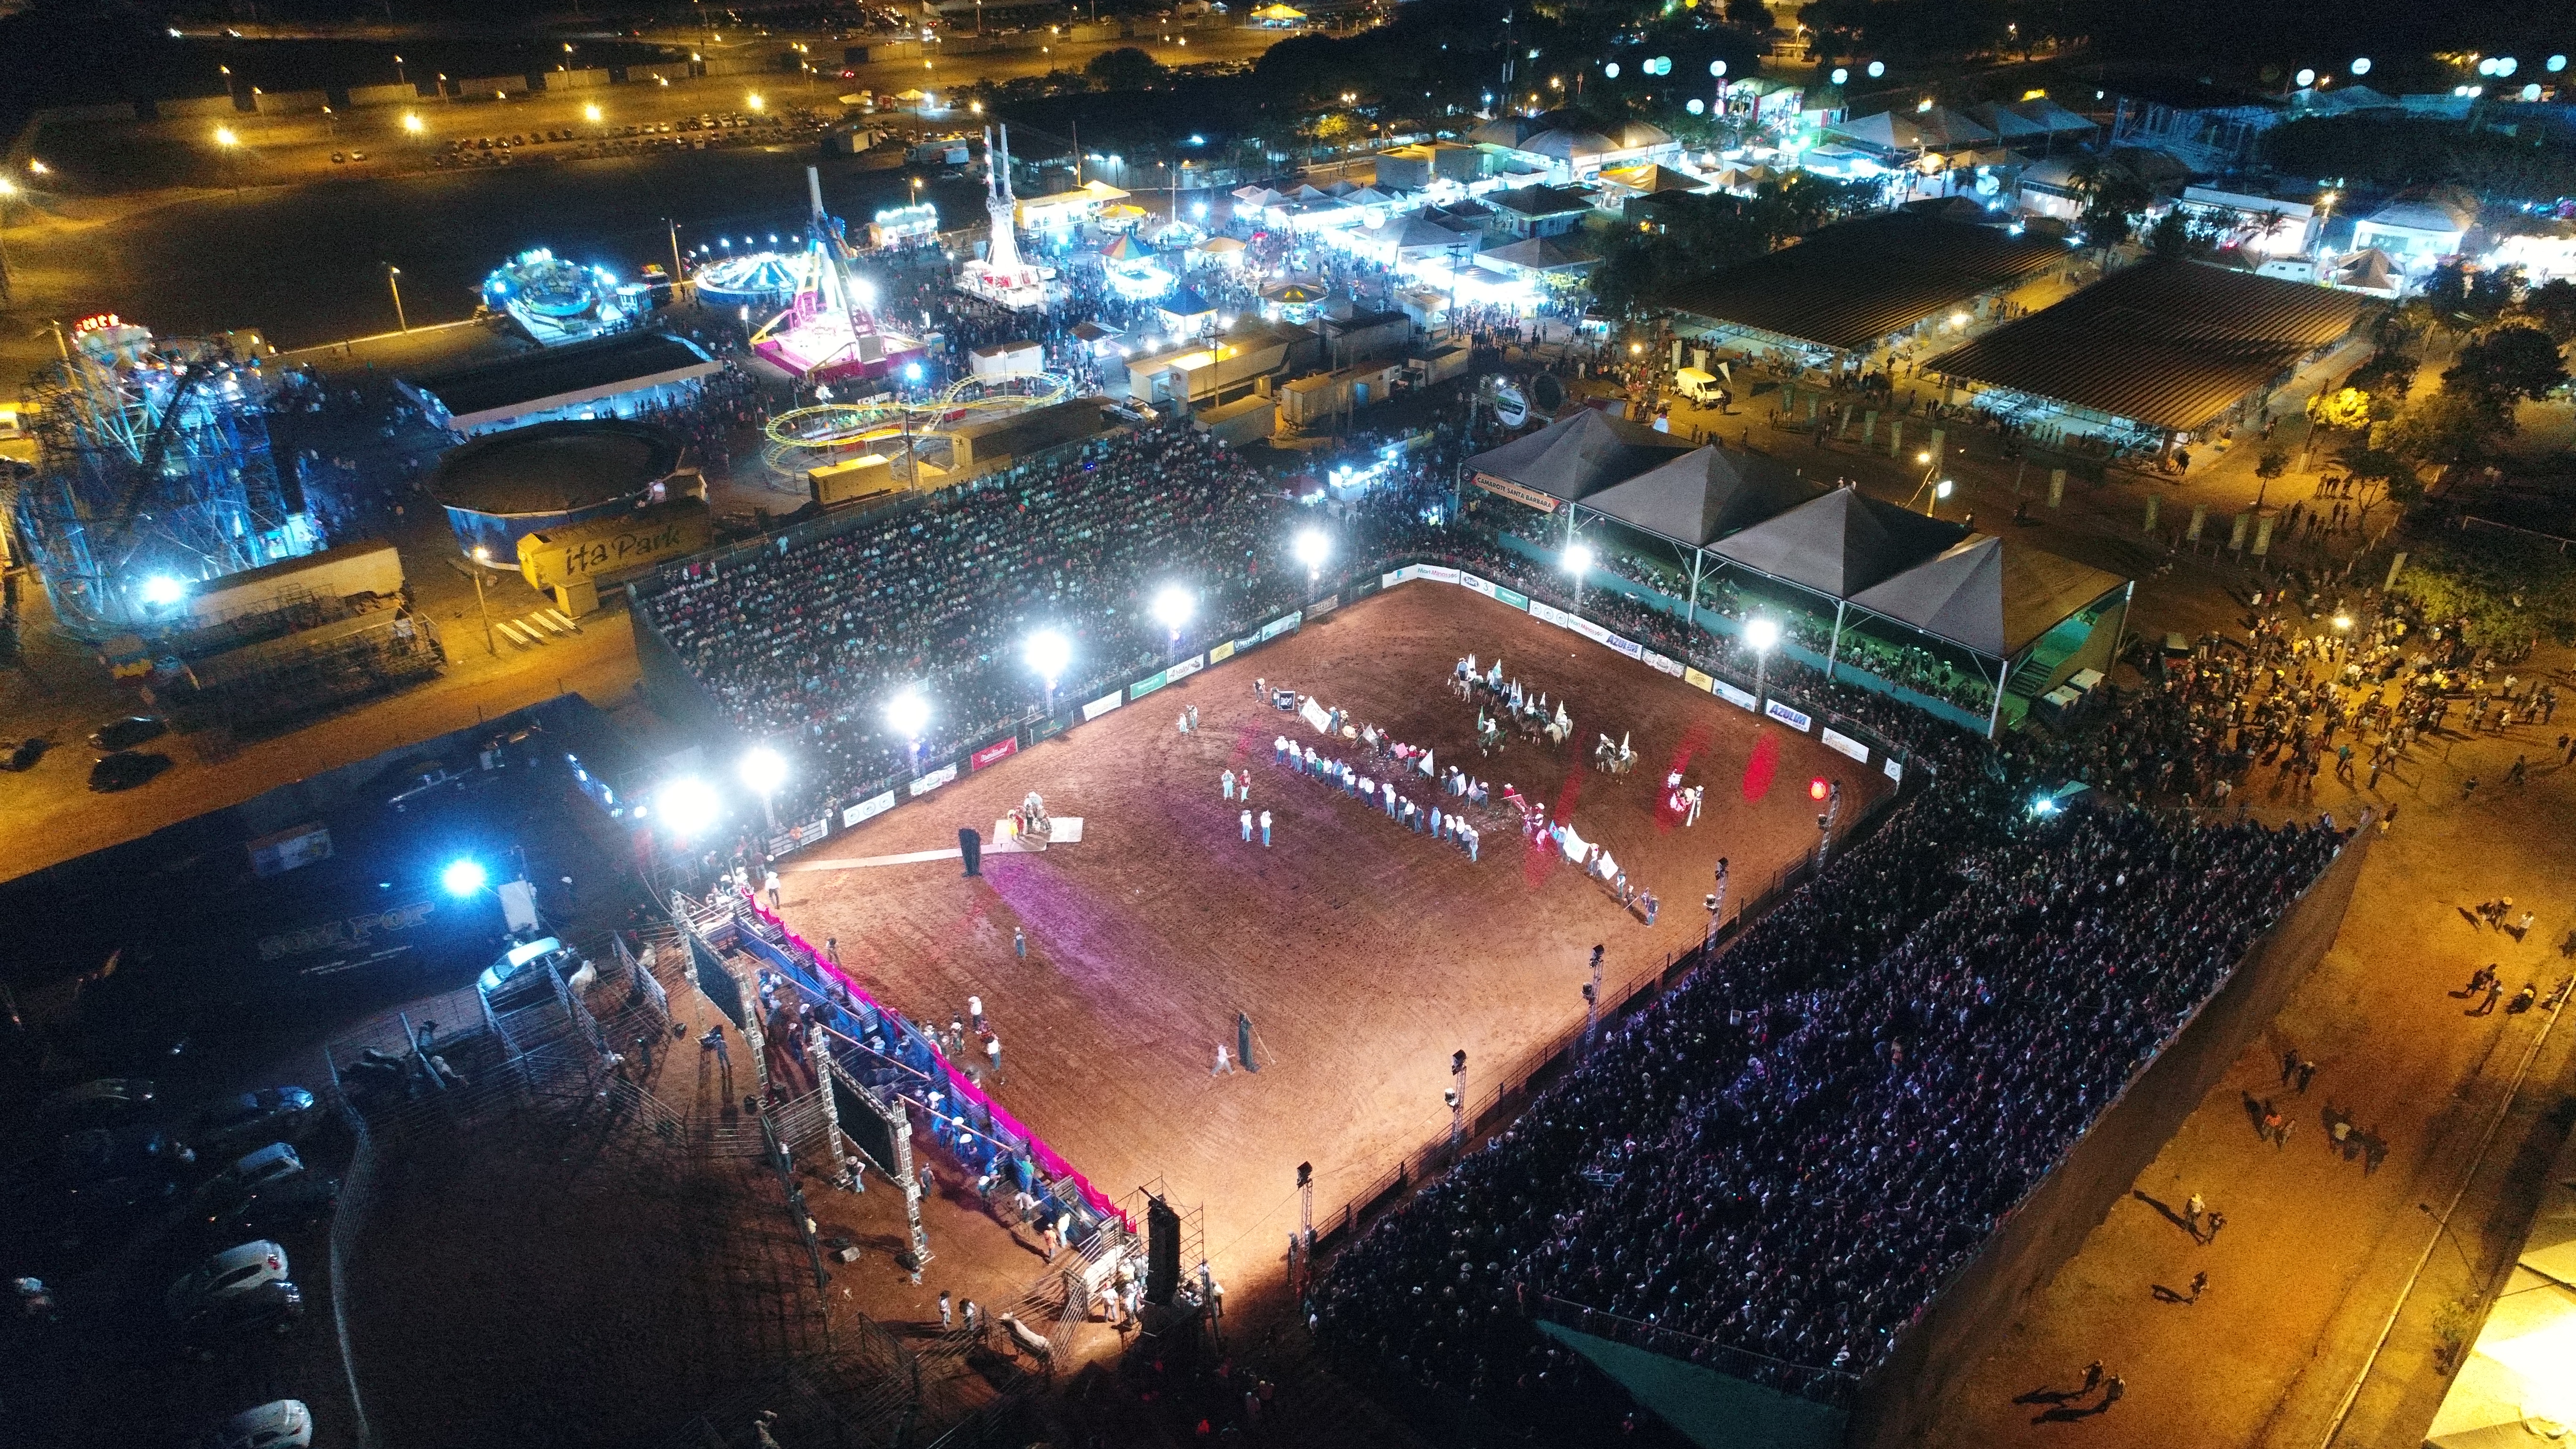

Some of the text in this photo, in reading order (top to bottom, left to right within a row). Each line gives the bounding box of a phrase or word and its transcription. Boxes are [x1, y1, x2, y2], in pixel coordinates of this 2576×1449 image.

[1477, 477, 1506, 491] CAMAROTE
[1507, 488, 1524, 498] SANTA
[1465, 577, 1478, 587] Start
[1569, 618, 1595, 633] Mart Minas
[1769, 704, 1807, 725] AZULIM
